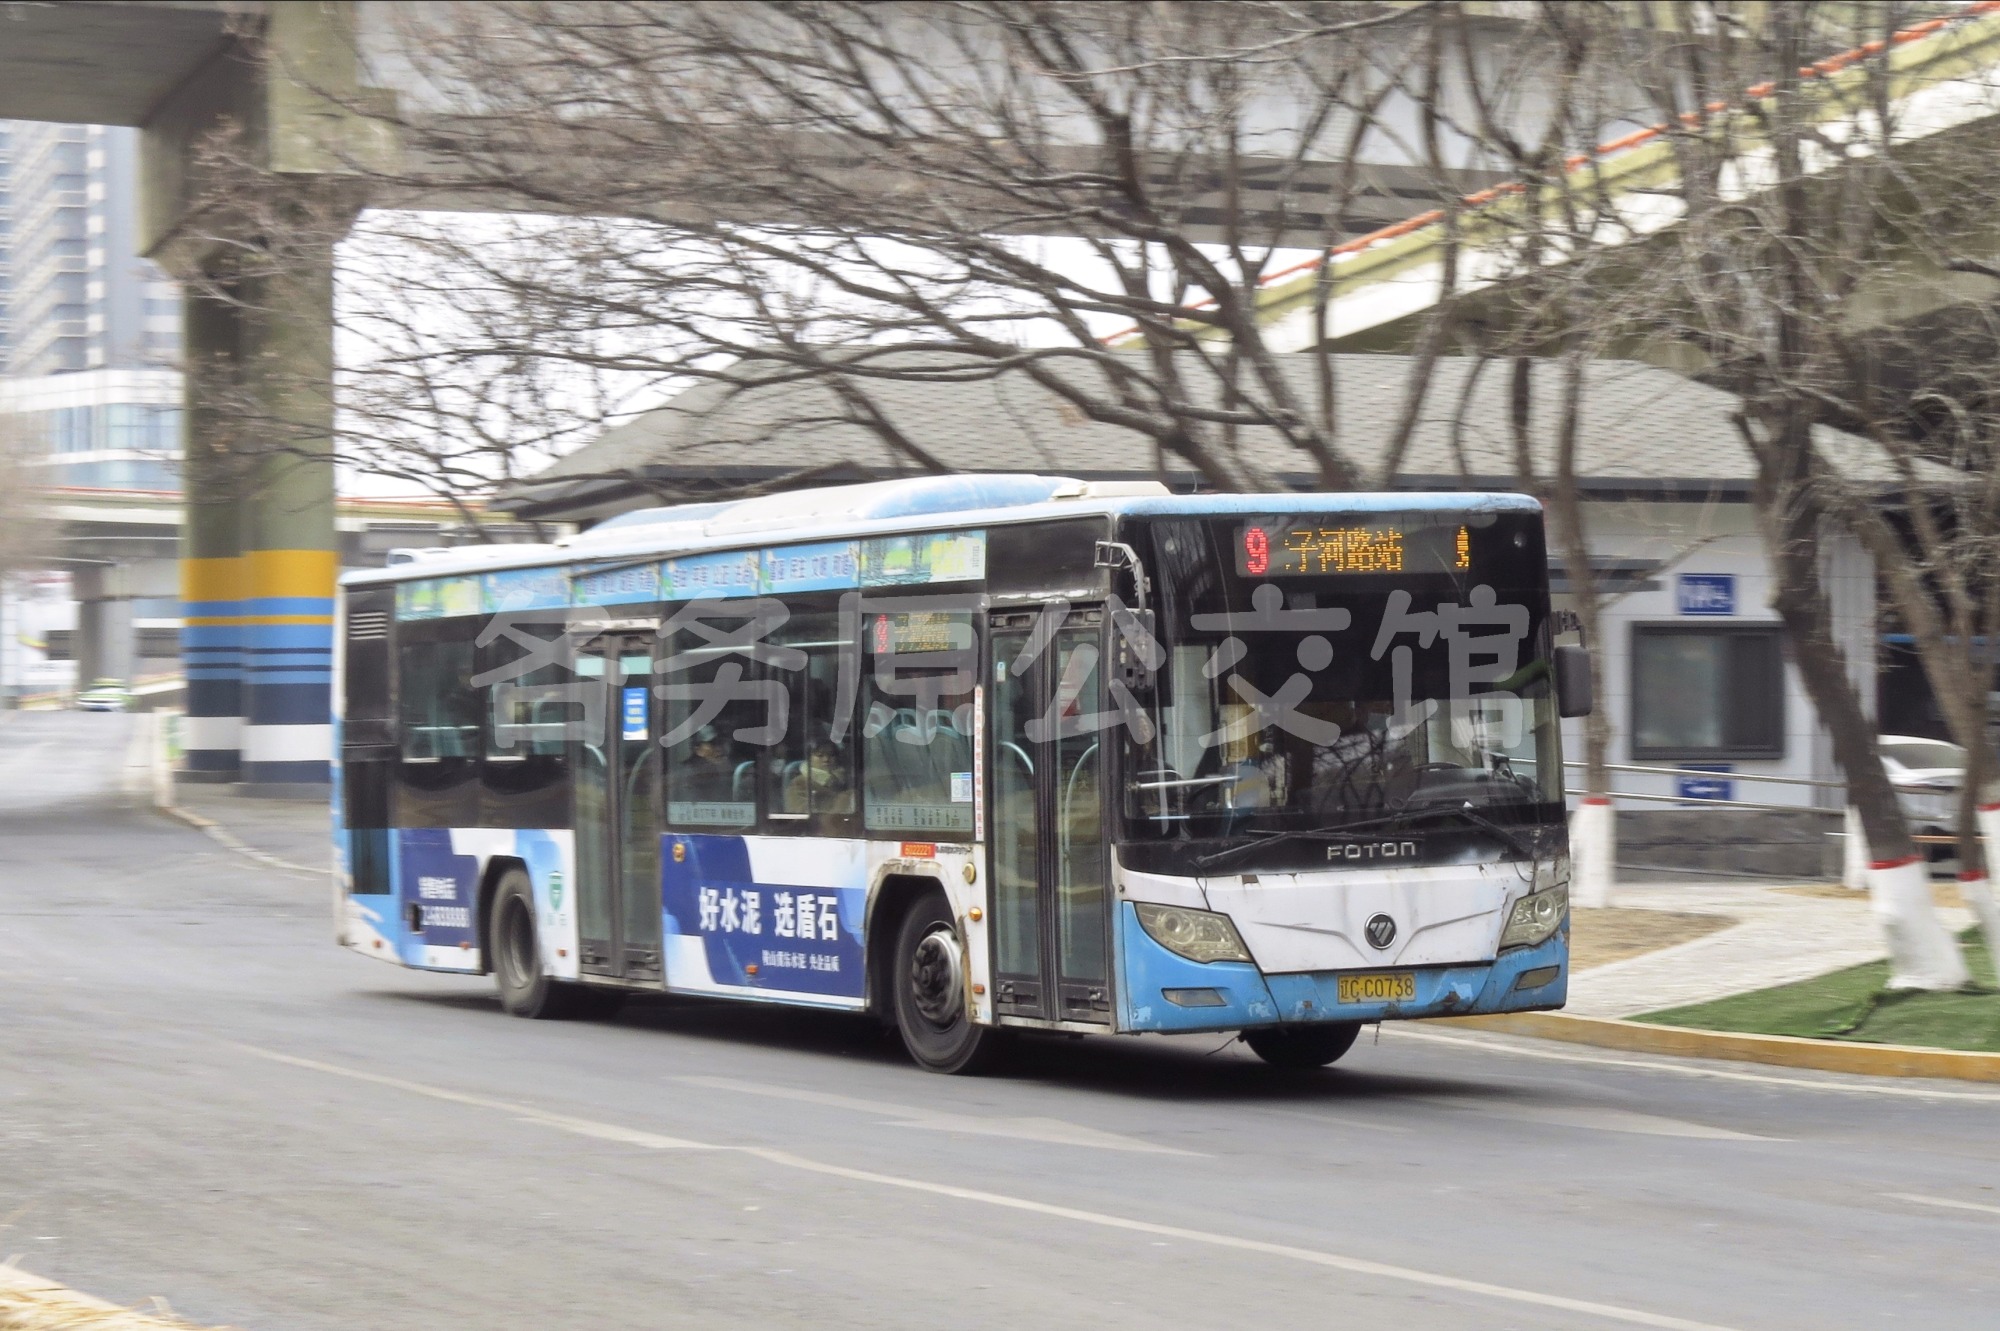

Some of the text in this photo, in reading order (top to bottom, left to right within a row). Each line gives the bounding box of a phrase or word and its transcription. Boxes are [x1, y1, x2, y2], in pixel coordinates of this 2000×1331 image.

[1246, 528, 1269, 573] 9
[1284, 527, 1403, 573] 子河路站
[1327, 841, 1417, 860] FOTON
[699, 886, 838, 941] 好水泥 选盾石
